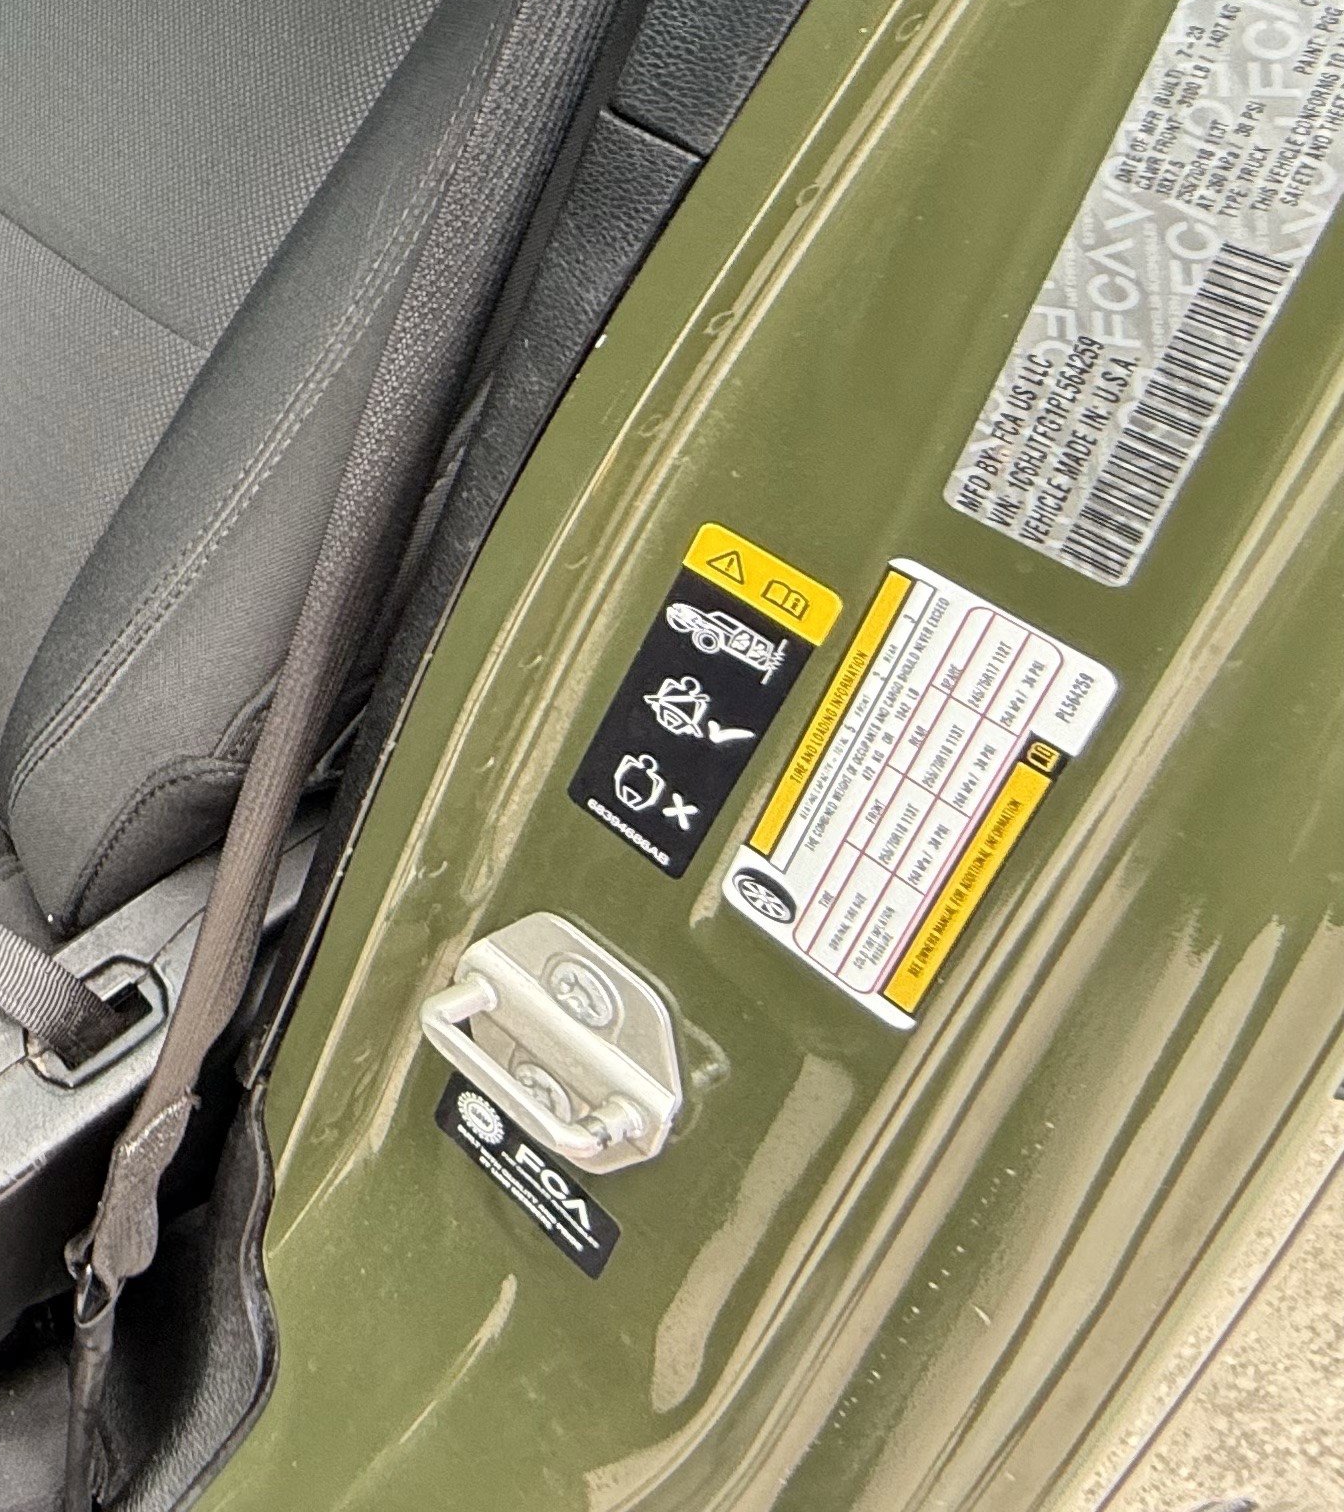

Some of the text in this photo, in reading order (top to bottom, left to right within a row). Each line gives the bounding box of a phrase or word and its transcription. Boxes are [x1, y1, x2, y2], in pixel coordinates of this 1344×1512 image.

[1136, 156, 1165, 189] GAWR
[1217, 3, 1241, 20] KG
[1138, 110, 1164, 135] MFR
[1115, 154, 1143, 183] DATE
[1130, 138, 1147, 153] OF
[1195, 194, 1216, 211] AT
[1239, 99, 1267, 121] PSI
[1236, 145, 1273, 183] TRUCK
[1249, 185, 1279, 212] THIS
[1265, 136, 1305, 184] VEHICLE
[1291, 72, 1340, 136] CONFORMS
[1280, 160, 1319, 207] SAFETY
[1304, 134, 1333, 161] AND
[1007, 385, 1037, 411] US
[1018, 354, 1053, 387] LLC
[986, 336, 1105, 527] VIN: 1C6HJTFG1PL564259
[991, 413, 1026, 445] FCA
[1019, 357, 1141, 544] VEHICLE MADE IN: U.S.A.
[957, 474, 991, 513] MFD
[792, 650, 868, 783] TIRE AND LOADING INFORMATION
[852, 722, 881, 765] OCCUPANTS
[874, 706, 889, 724] AND
[883, 681, 903, 708] CARGO
[897, 651, 919, 683] SHOULD
[914, 626, 933, 652] NEVER
[927, 597, 949, 628] EXCEED
[1055, 671, 1094, 724] PL564259
[935, 905, 958, 937] MANUAL
[952, 890, 967, 908] FOR
[960, 848, 992, 893] ADDITIONAL
[985, 796, 1022, 851] INFORMATION
[515, 1143, 591, 1231] FCA
